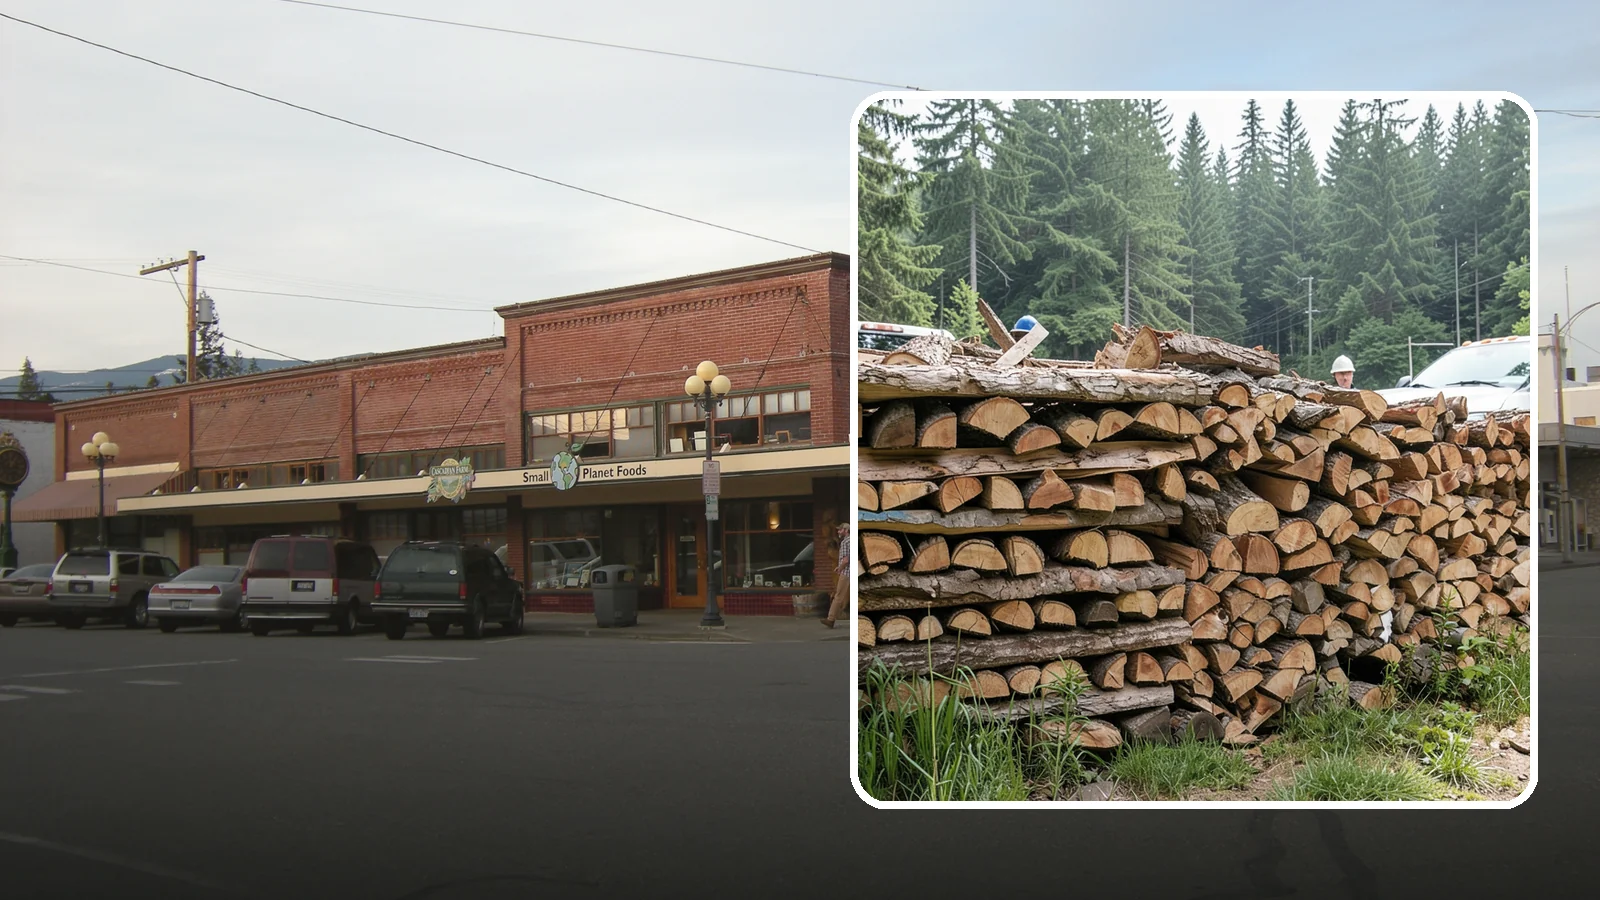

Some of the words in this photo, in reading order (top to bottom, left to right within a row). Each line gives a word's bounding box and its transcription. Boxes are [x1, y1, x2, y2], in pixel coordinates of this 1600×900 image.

[523, 471, 549, 483] Small
[583, 467, 614, 479] Planet
[617, 464, 647, 477] Foods
